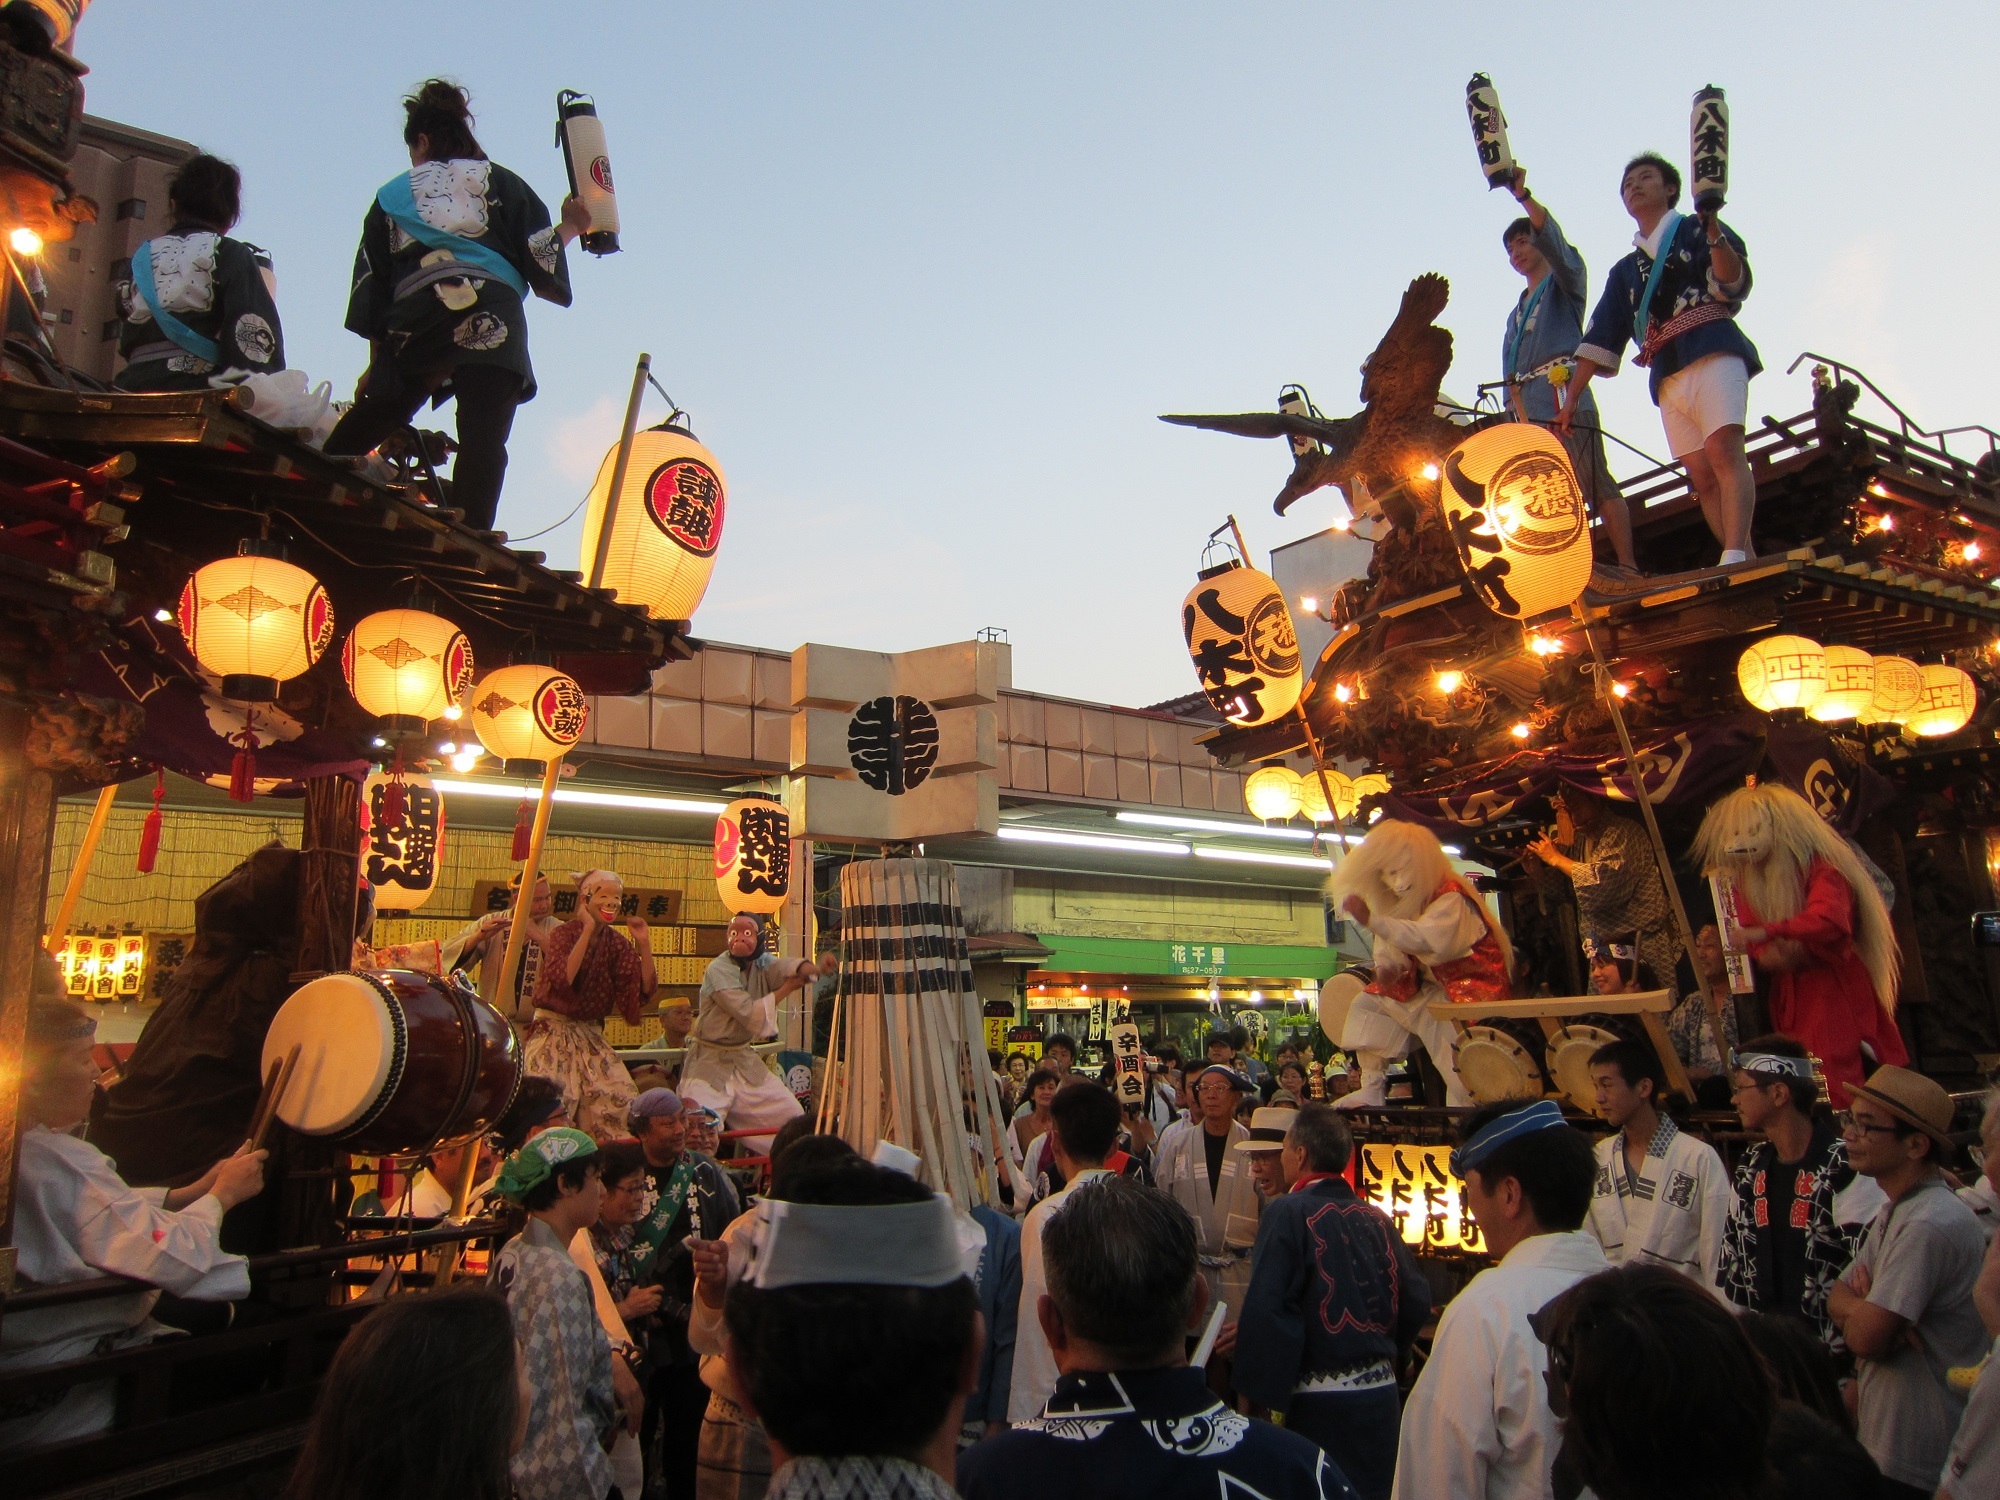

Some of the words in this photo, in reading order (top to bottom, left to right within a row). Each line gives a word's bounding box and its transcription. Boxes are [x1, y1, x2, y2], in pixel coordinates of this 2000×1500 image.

[1694, 102, 1728, 184] 八木町
[1184, 588, 1265, 723] 八木町
[1172, 944, 1225, 964] 花千里
[991, 1019, 999, 1050] アサヒ
[1090, 1004, 1100, 1039] 生ビール
[1420, 1152, 1448, 1243] 八木町
